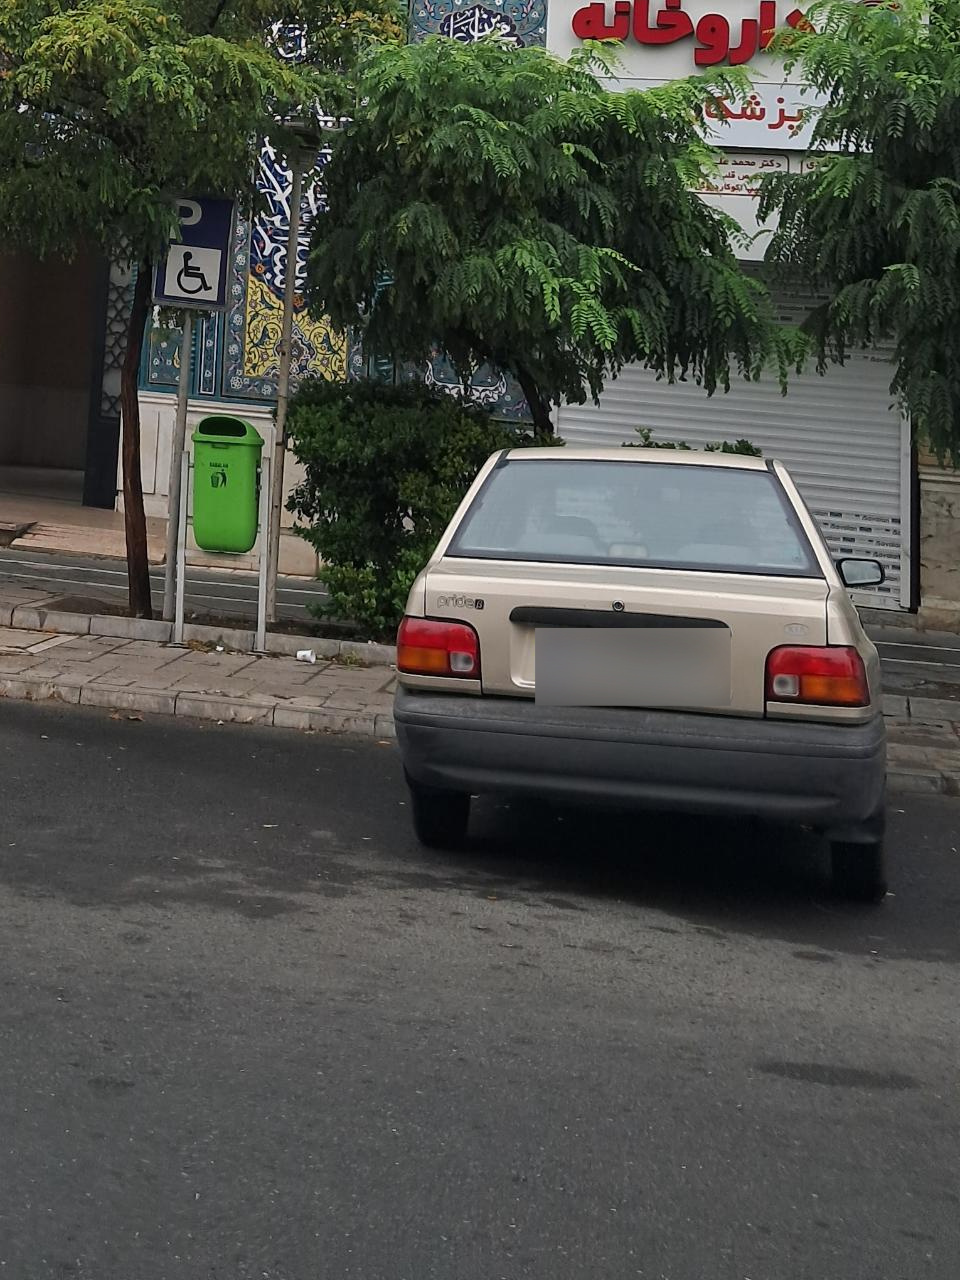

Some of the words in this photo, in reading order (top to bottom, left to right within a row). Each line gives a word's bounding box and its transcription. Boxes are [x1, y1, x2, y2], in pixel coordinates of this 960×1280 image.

[704, 94, 808, 137] پزشکا
[731, 158, 756, 168] محمد
[758, 159, 782, 169] دکتر
[436, 593, 474, 609] pride
